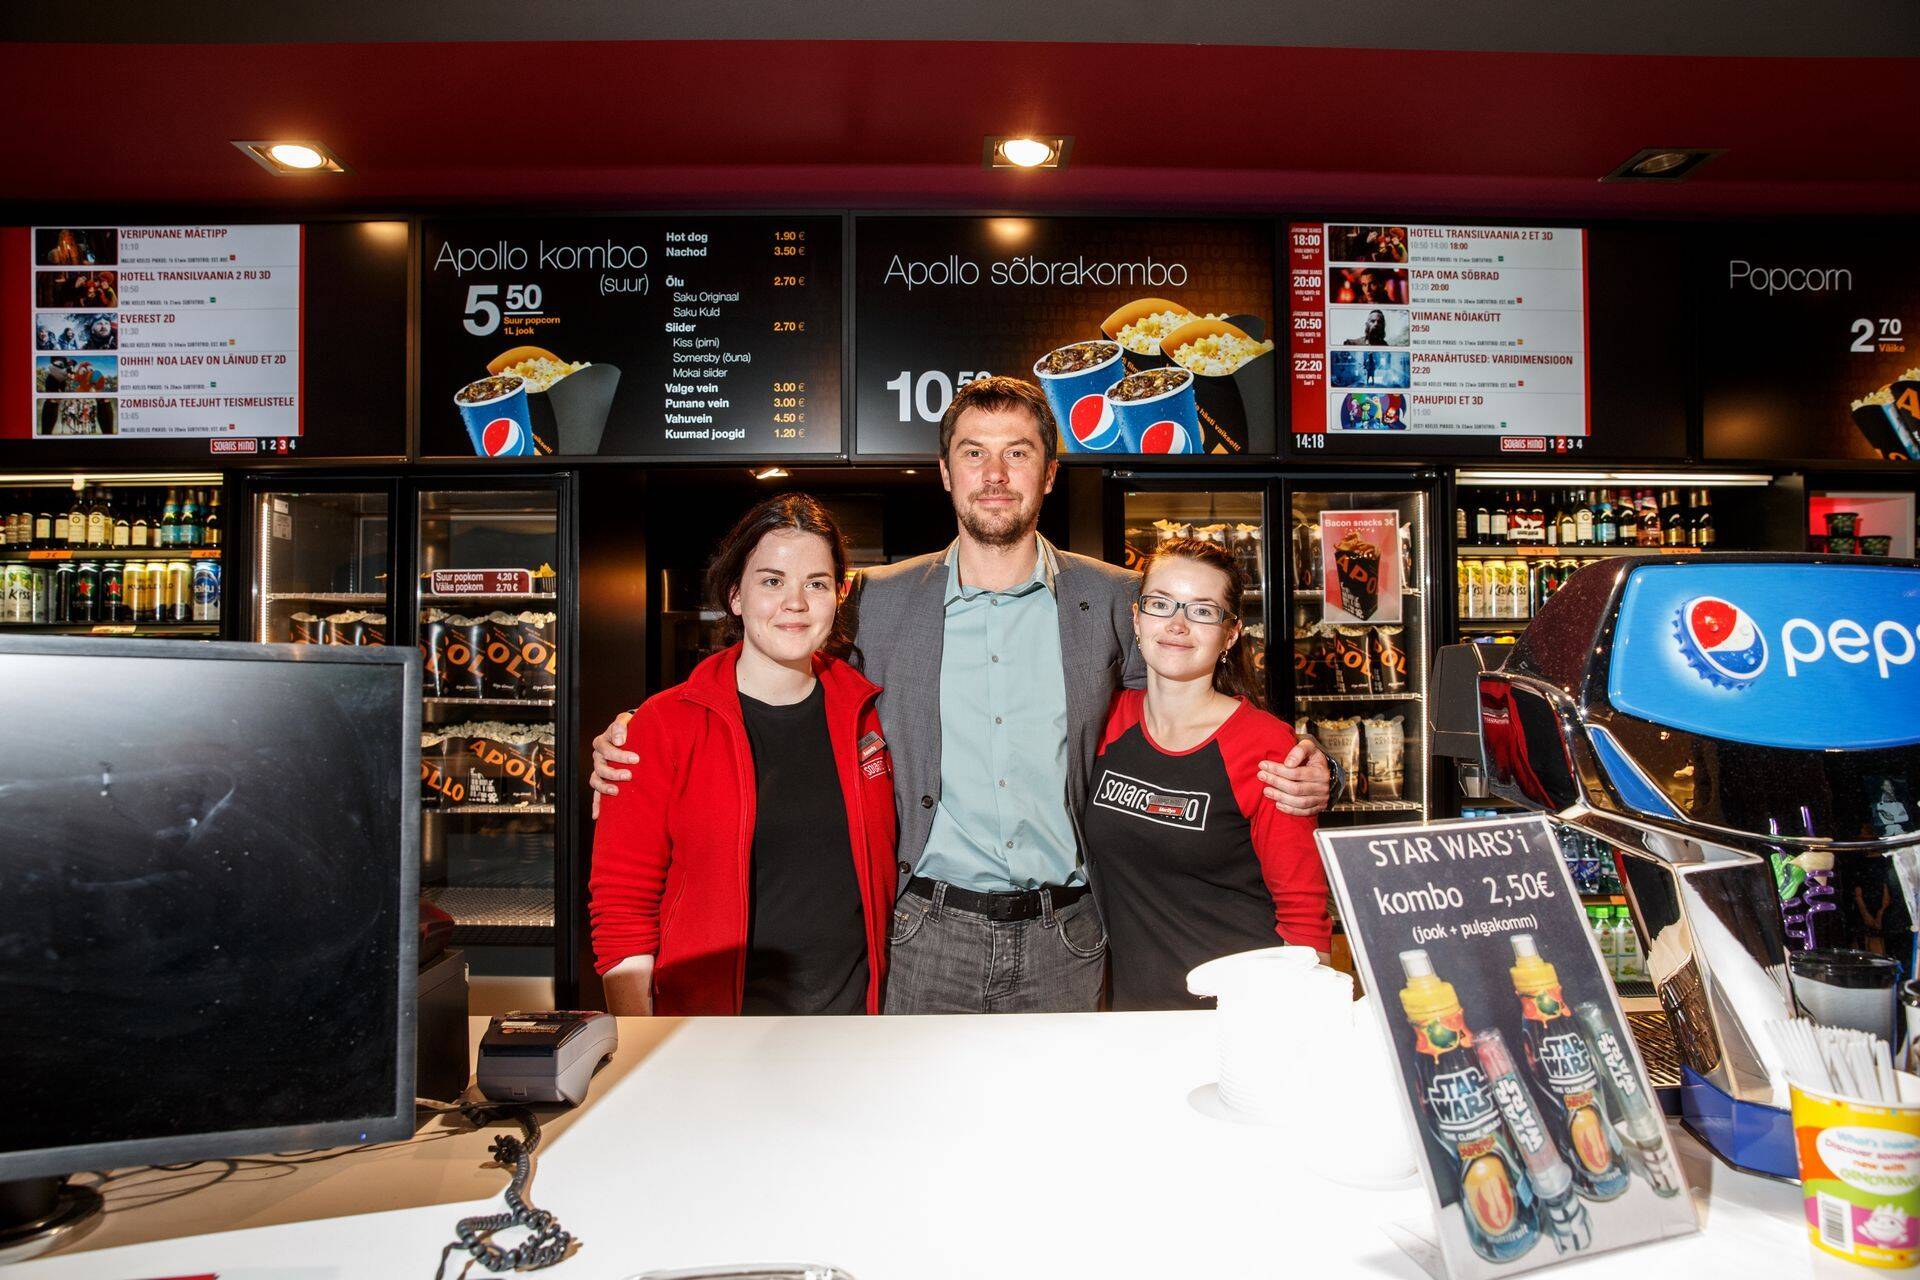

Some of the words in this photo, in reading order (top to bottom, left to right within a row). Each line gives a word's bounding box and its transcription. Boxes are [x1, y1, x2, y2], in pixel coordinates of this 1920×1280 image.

[120, 229, 181, 239] VERIPUNANE
[185, 227, 227, 238] MÄETIPP
[666, 232, 686, 242] Hot
[688, 232, 708, 244] dog
[774, 231, 796, 241] 1.90
[798, 231, 805, 241] €
[1410, 228, 1444, 239] HOTELL
[1447, 229, 1519, 240] TRANSILVAANIA
[1521, 231, 1527, 240] 2
[1529, 231, 1540, 241] ET
[1541, 231, 1553, 241] 3D
[1293, 234, 1321, 246] 18:00
[1450, 242, 1468, 250] 18:00
[666, 246, 707, 257] Nachod
[774, 246, 796, 256] 3.50
[798, 246, 805, 256] €
[434, 240, 528, 277] Apollo
[539, 239, 648, 270] kombo
[120, 272, 155, 281] HOTELL
[158, 271, 233, 281] TRANSILVAANIA
[236, 271, 241, 280] 2
[244, 271, 257, 280] RU
[259, 270, 271, 280] 3D
[884, 254, 980, 291] Apollo
[990, 255, 1188, 287] sõbrakombo
[1410, 270, 1434, 280] TAPA
[1436, 270, 1459, 280] OMA
[1462, 269, 1500, 281] SÕBRAD
[1730, 260, 1852, 296] Popcorn
[599, 273, 649, 296] (suur)
[665, 275, 684, 287] Õlu
[774, 276, 796, 286] 2.70
[798, 276, 805, 286] €
[1293, 276, 1321, 288] 20:00
[1430, 283, 1449, 291] 20:00
[673, 292, 697, 302] Saku
[699, 291, 740, 304] Originaal
[462, 285, 501, 337] 5
[505, 284, 543, 310] 50
[673, 307, 697, 317] Saku
[700, 306, 720, 317] Kuld
[1411, 312, 1452, 322] VIIMANE
[1454, 310, 1501, 322] NÕIAKÜTT
[120, 314, 160, 323] EVEREST
[164, 314, 175, 323] 2D
[503, 317, 523, 325] Suur
[525, 316, 561, 325] popcorn
[1294, 318, 1322, 330] 20:50
[515, 326, 535, 336] jook
[665, 323, 696, 333] Siider
[774, 322, 796, 332] 2.70
[798, 322, 805, 332] €
[1411, 324, 1430, 333] 20:50
[1850, 318, 1875, 353] 2
[1878, 318, 1902, 335] 70
[673, 338, 693, 348] Kiss
[695, 337, 720, 349] (pirni)
[1879, 343, 1906, 353] Väike
[120, 356, 154, 366] OIHHH!
[157, 356, 177, 366] NOA
[180, 356, 204, 365] LAEV
[206, 355, 220, 365] ON
[223, 353, 258, 365] LÄINUD
[261, 355, 272, 365] ET
[274, 355, 286, 364] 2D
[673, 352, 720, 364] Somersby
[723, 352, 752, 364] (õuna)
[1412, 351, 1491, 364] PARANÄHTUSED:
[1492, 354, 1573, 365] VARIDIMENSIOON
[1294, 360, 1322, 372] 22:20
[1412, 366, 1431, 374] 22:20
[673, 368, 701, 378] Mokai
[703, 368, 728, 378] siider
[665, 383, 694, 394] Valge
[696, 383, 719, 393] vein
[773, 383, 796, 392] 3.00
[798, 383, 805, 392] €
[120, 396, 177, 408] ZOMBISÕJA
[181, 398, 220, 408] TEEJUHT
[223, 397, 295, 407] TEISMELISTELE
[886, 370, 953, 423] 10
[1413, 395, 1457, 405] PAHUPIDI
[1459, 395, 1469, 405] ET
[1471, 396, 1484, 405] 3D
[665, 398, 705, 409] Punane
[707, 398, 729, 408] vein
[773, 398, 796, 408] 3.00
[798, 398, 805, 408] €
[665, 414, 713, 424] Vahuvein
[773, 413, 796, 423] 4.50
[798, 413, 805, 423] €
[665, 429, 710, 439] Kuumad
[711, 428, 746, 441] joogid
[774, 428, 796, 438] 1.20
[798, 428, 805, 438] €
[261, 440, 266, 450] 1
[270, 440, 276, 450] 2
[279, 440, 286, 450] 3
[289, 440, 296, 450] 4
[1296, 434, 1325, 449] 14:18
[1549, 439, 1555, 449] 1
[1557, 439, 1565, 449] 2
[1567, 439, 1574, 449] 3
[1576, 439, 1583, 449] 4
[1325, 519, 1352, 528] Bacon
[1353, 519, 1383, 527] snacks
[1384, 518, 1395, 527] 3€
[436, 573, 453, 581] Suur
[454, 573, 484, 583] popkorn
[496, 573, 512, 582] 4,20
[436, 583, 454, 592] Väike
[455, 583, 484, 593] popkorn
[496, 583, 512, 593] 2,70
[1782, 618, 1920, 679] pep
[1368, 836, 1439, 868] STAR
[1373, 885, 1464, 916] kombo
[1482, 870, 1555, 908] 2,50€
[1412, 925, 1448, 945] (jook
[1449, 925, 1458, 935] +
[1460, 913, 1539, 942] pulgakomm)
[1541, 1034, 1587, 1058] STAR
[1543, 1051, 1590, 1077] WARS
[1429, 1067, 1488, 1100] STAR
[1432, 1090, 1494, 1122] WARS
